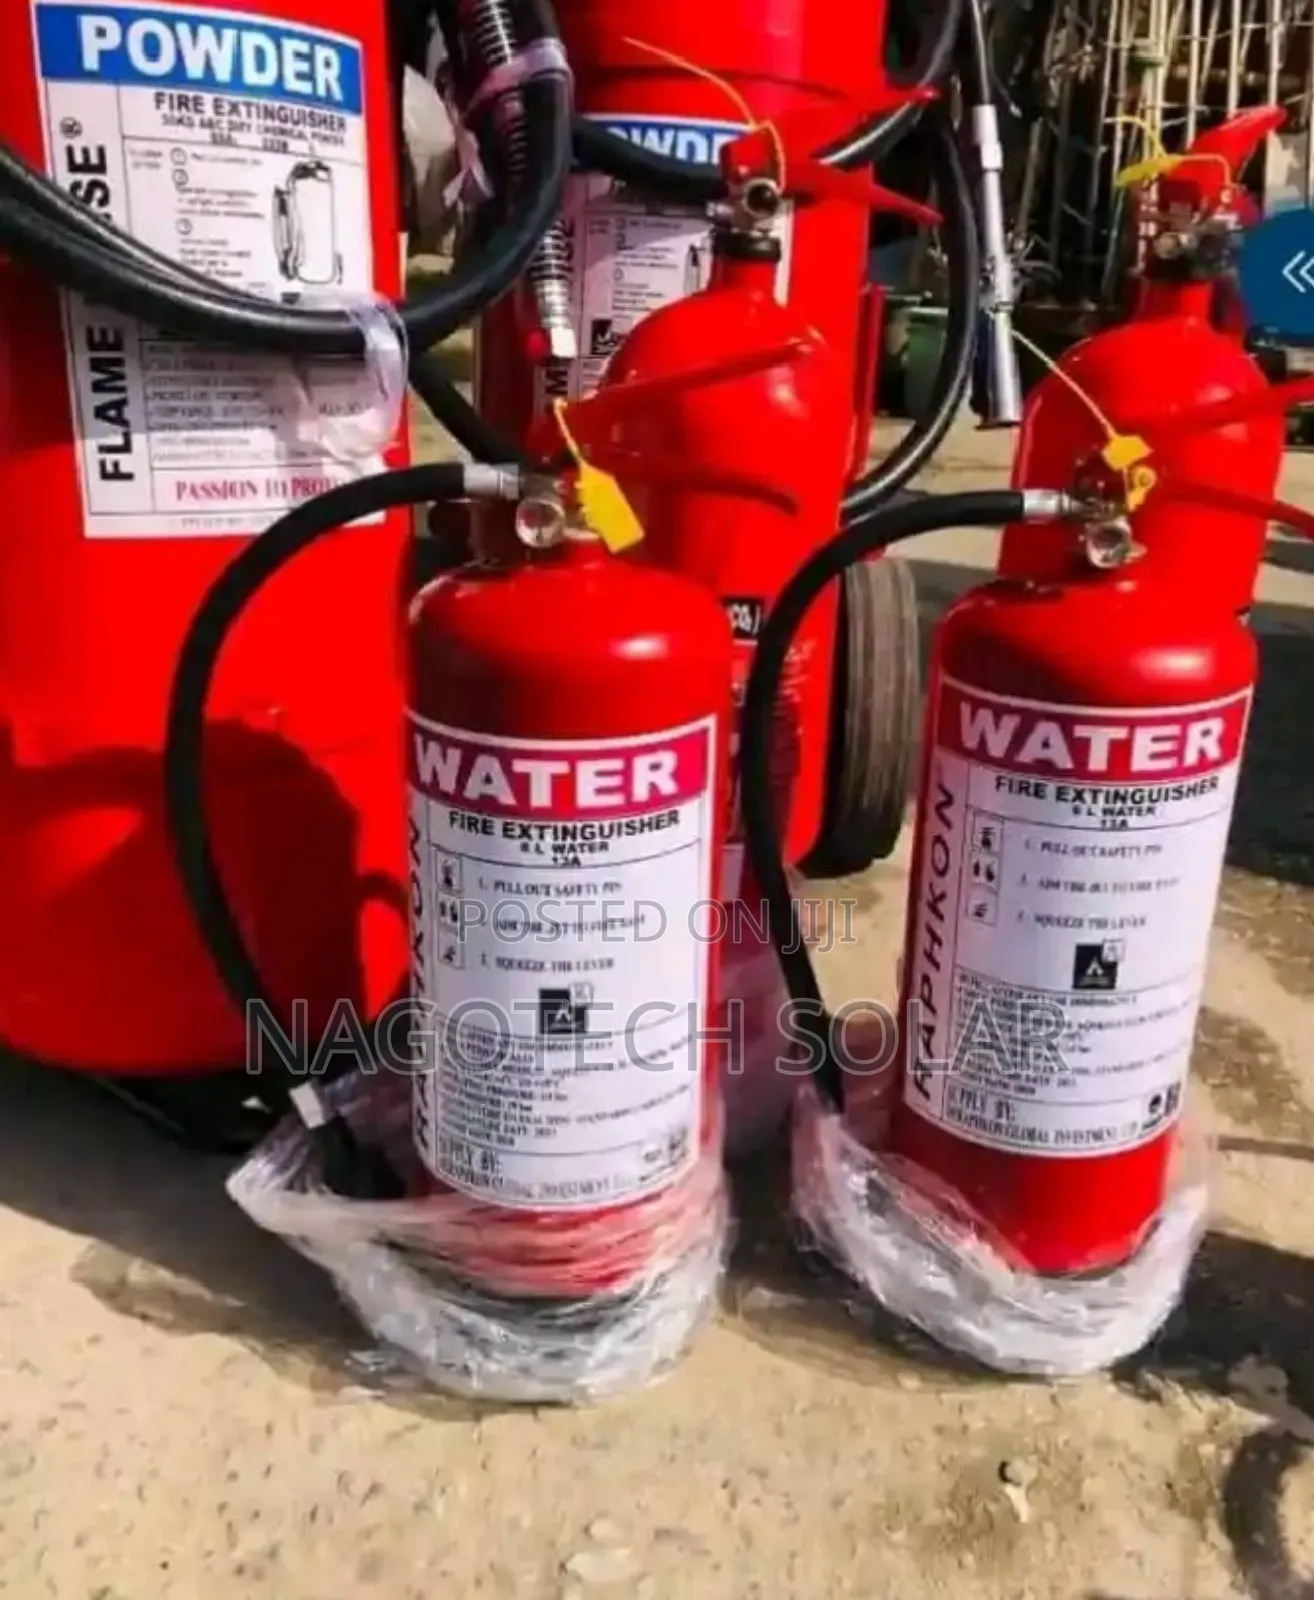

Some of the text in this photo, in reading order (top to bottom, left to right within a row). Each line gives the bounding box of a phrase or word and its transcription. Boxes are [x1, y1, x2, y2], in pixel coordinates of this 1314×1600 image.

[76, 14, 344, 101] POWDER
[154, 91, 347, 132] FIRE EXTINGUISHER
[86, 324, 135, 481] FLAME
[176, 479, 258, 500] PASSION
[959, 700, 1226, 773] WATER
[413, 733, 680, 809] WATER
[994, 775, 1220, 806] FIRE EXTINGUISHER
[448, 810, 680, 842] FIRE EXTINGUISHER
[1101, 805, 1157, 818] WATER
[551, 840, 610, 855] WATER
